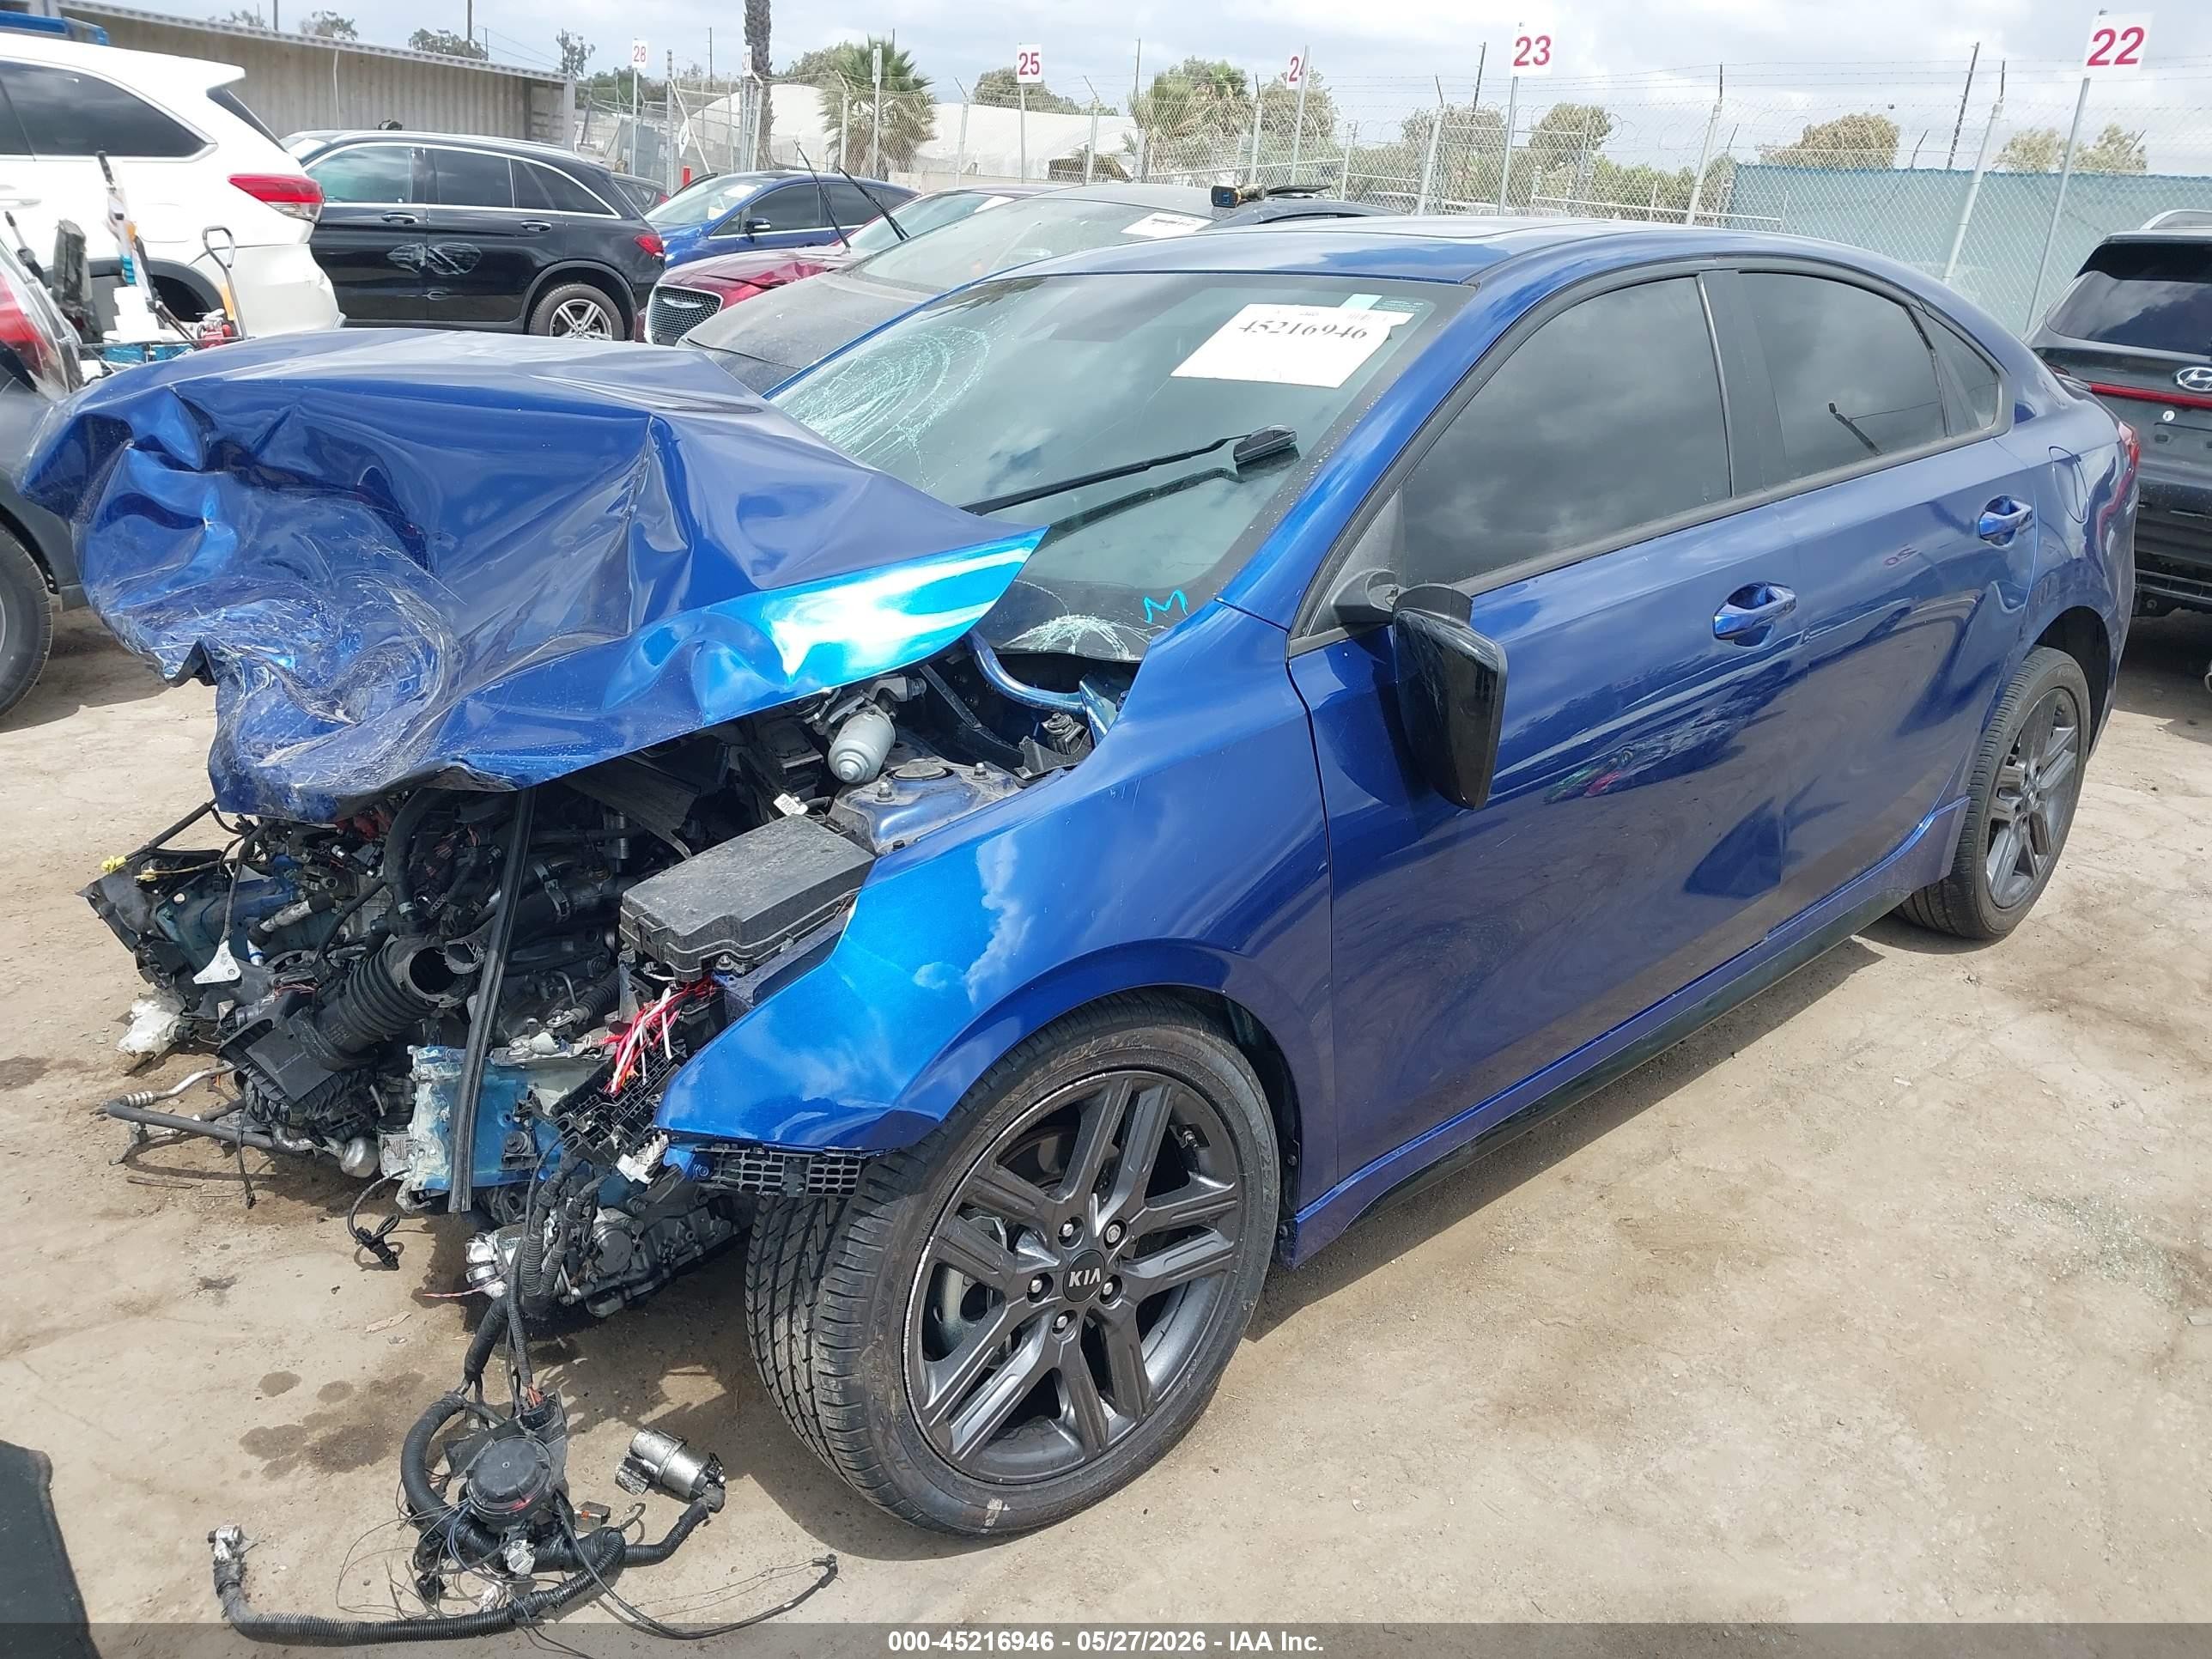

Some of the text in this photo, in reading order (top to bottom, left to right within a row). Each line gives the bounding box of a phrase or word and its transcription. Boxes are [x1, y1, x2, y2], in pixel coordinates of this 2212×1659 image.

[633, 46, 646, 63] 28
[1513, 35, 1551, 66] 23
[2086, 26, 2145, 66] 22
[1018, 52, 1040, 76] 25
[1239, 320, 1368, 338] 45216946
[1144, 589, 1188, 624] M
[1068, 1267, 1101, 1288] KIA
